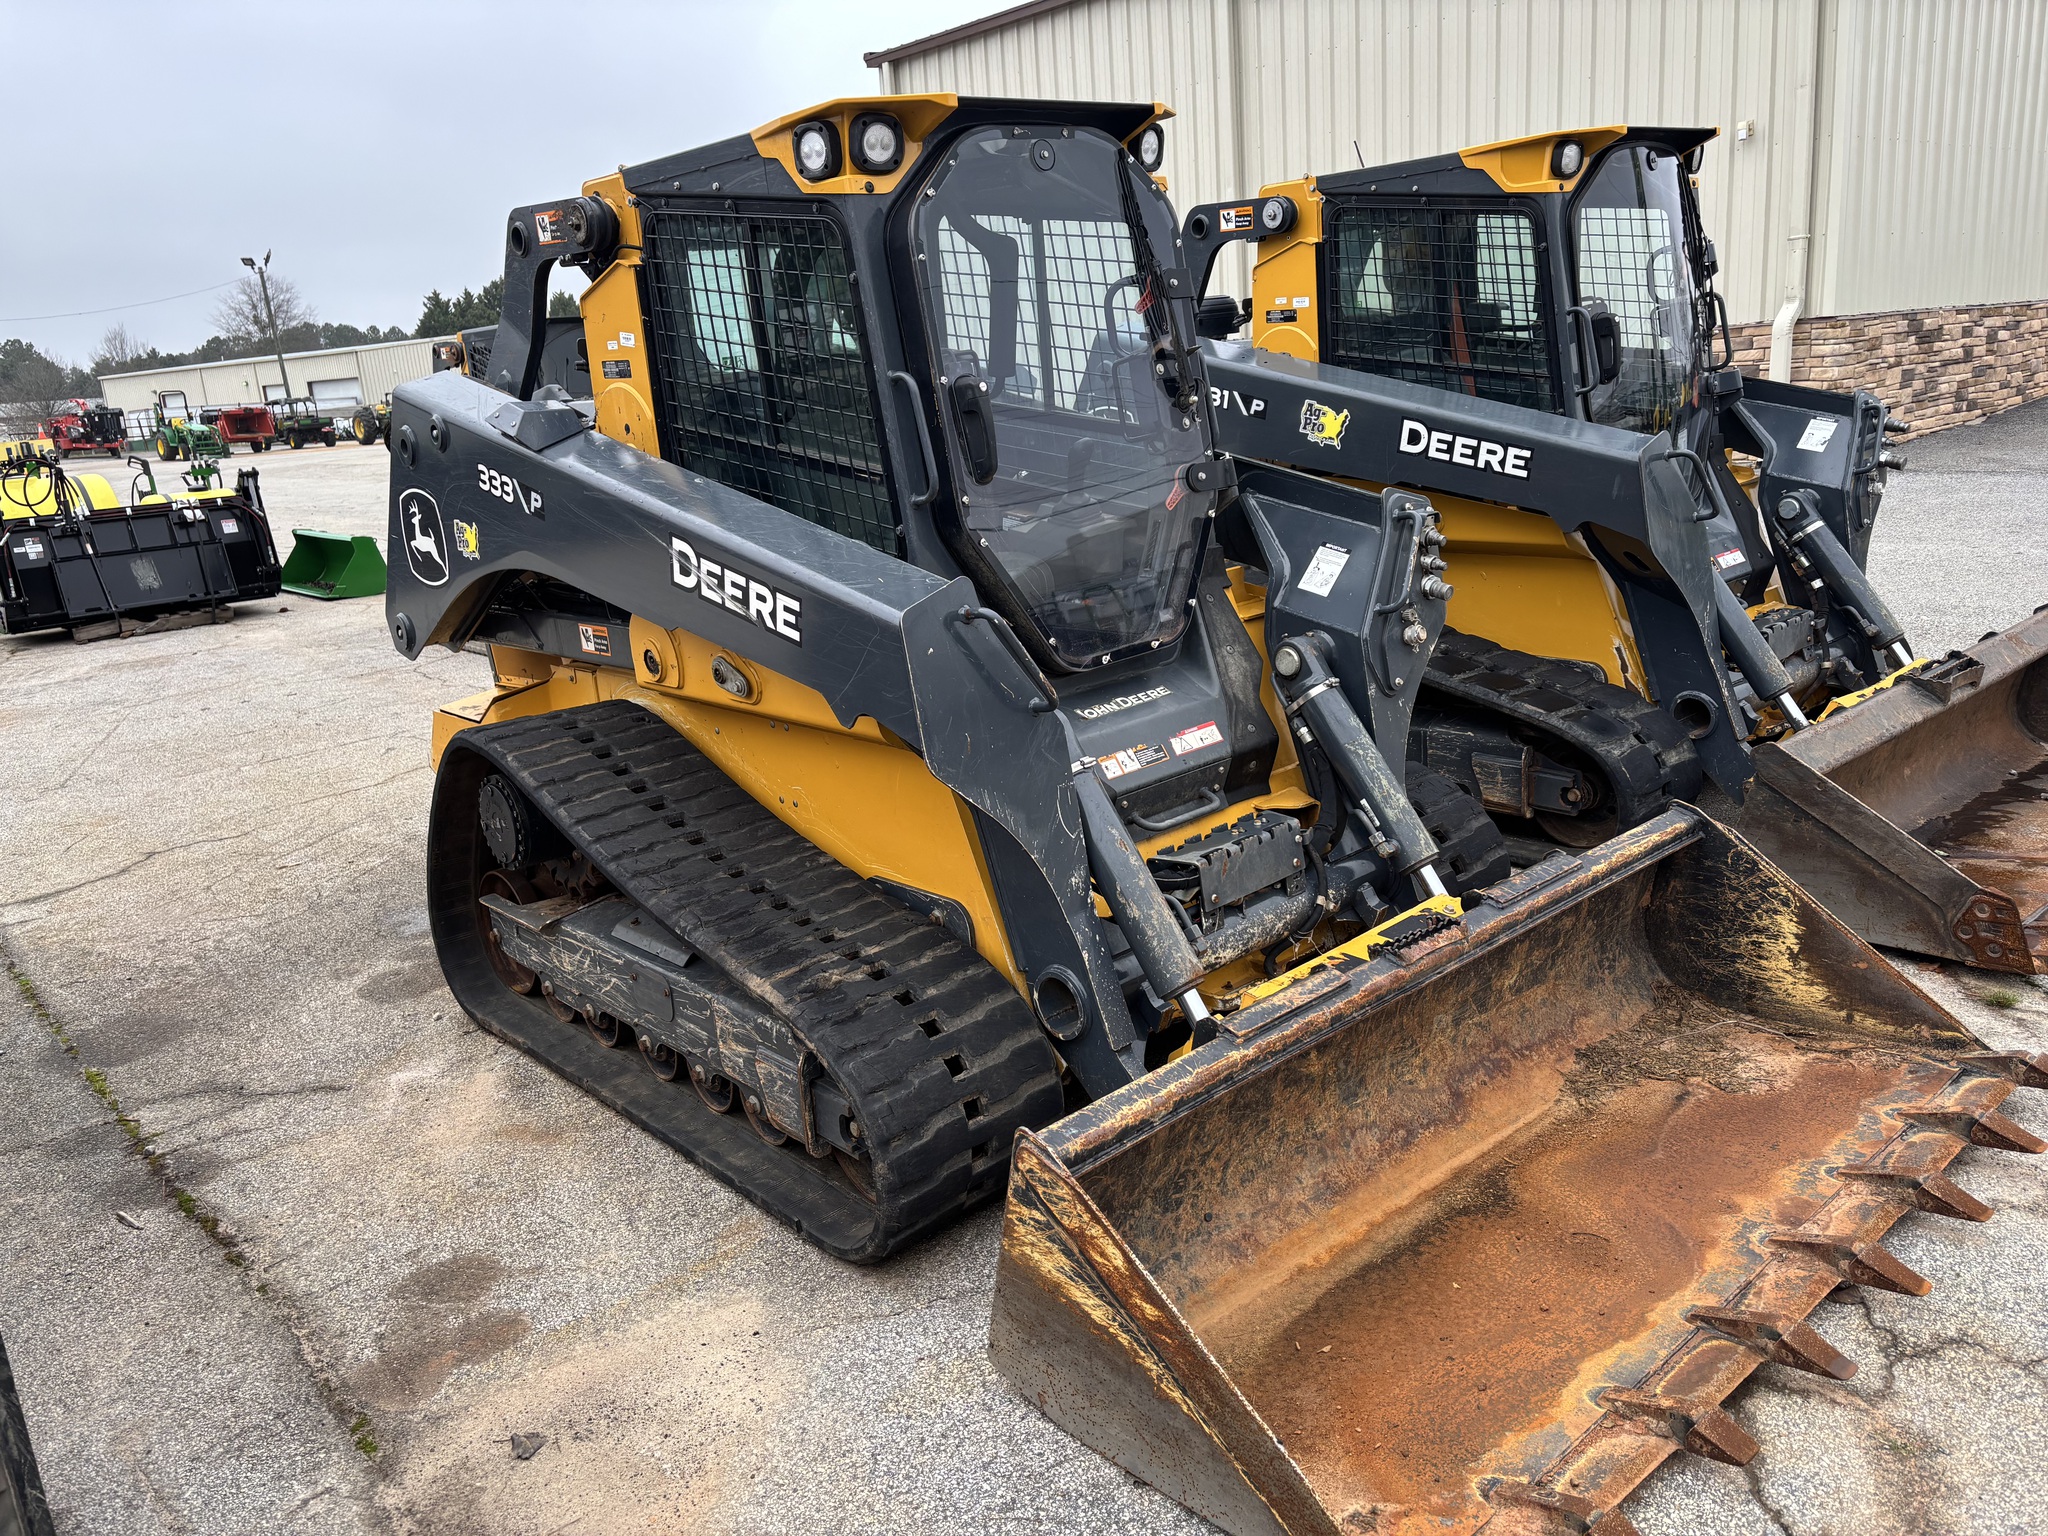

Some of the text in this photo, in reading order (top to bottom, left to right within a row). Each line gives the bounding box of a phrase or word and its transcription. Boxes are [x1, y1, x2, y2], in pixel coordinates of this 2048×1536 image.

[1302, 416, 1325, 433] Pro
[1399, 419, 1532, 478] DEERE
[671, 535, 801, 642] DEERE
[1115, 686, 1172, 709] DEERE
